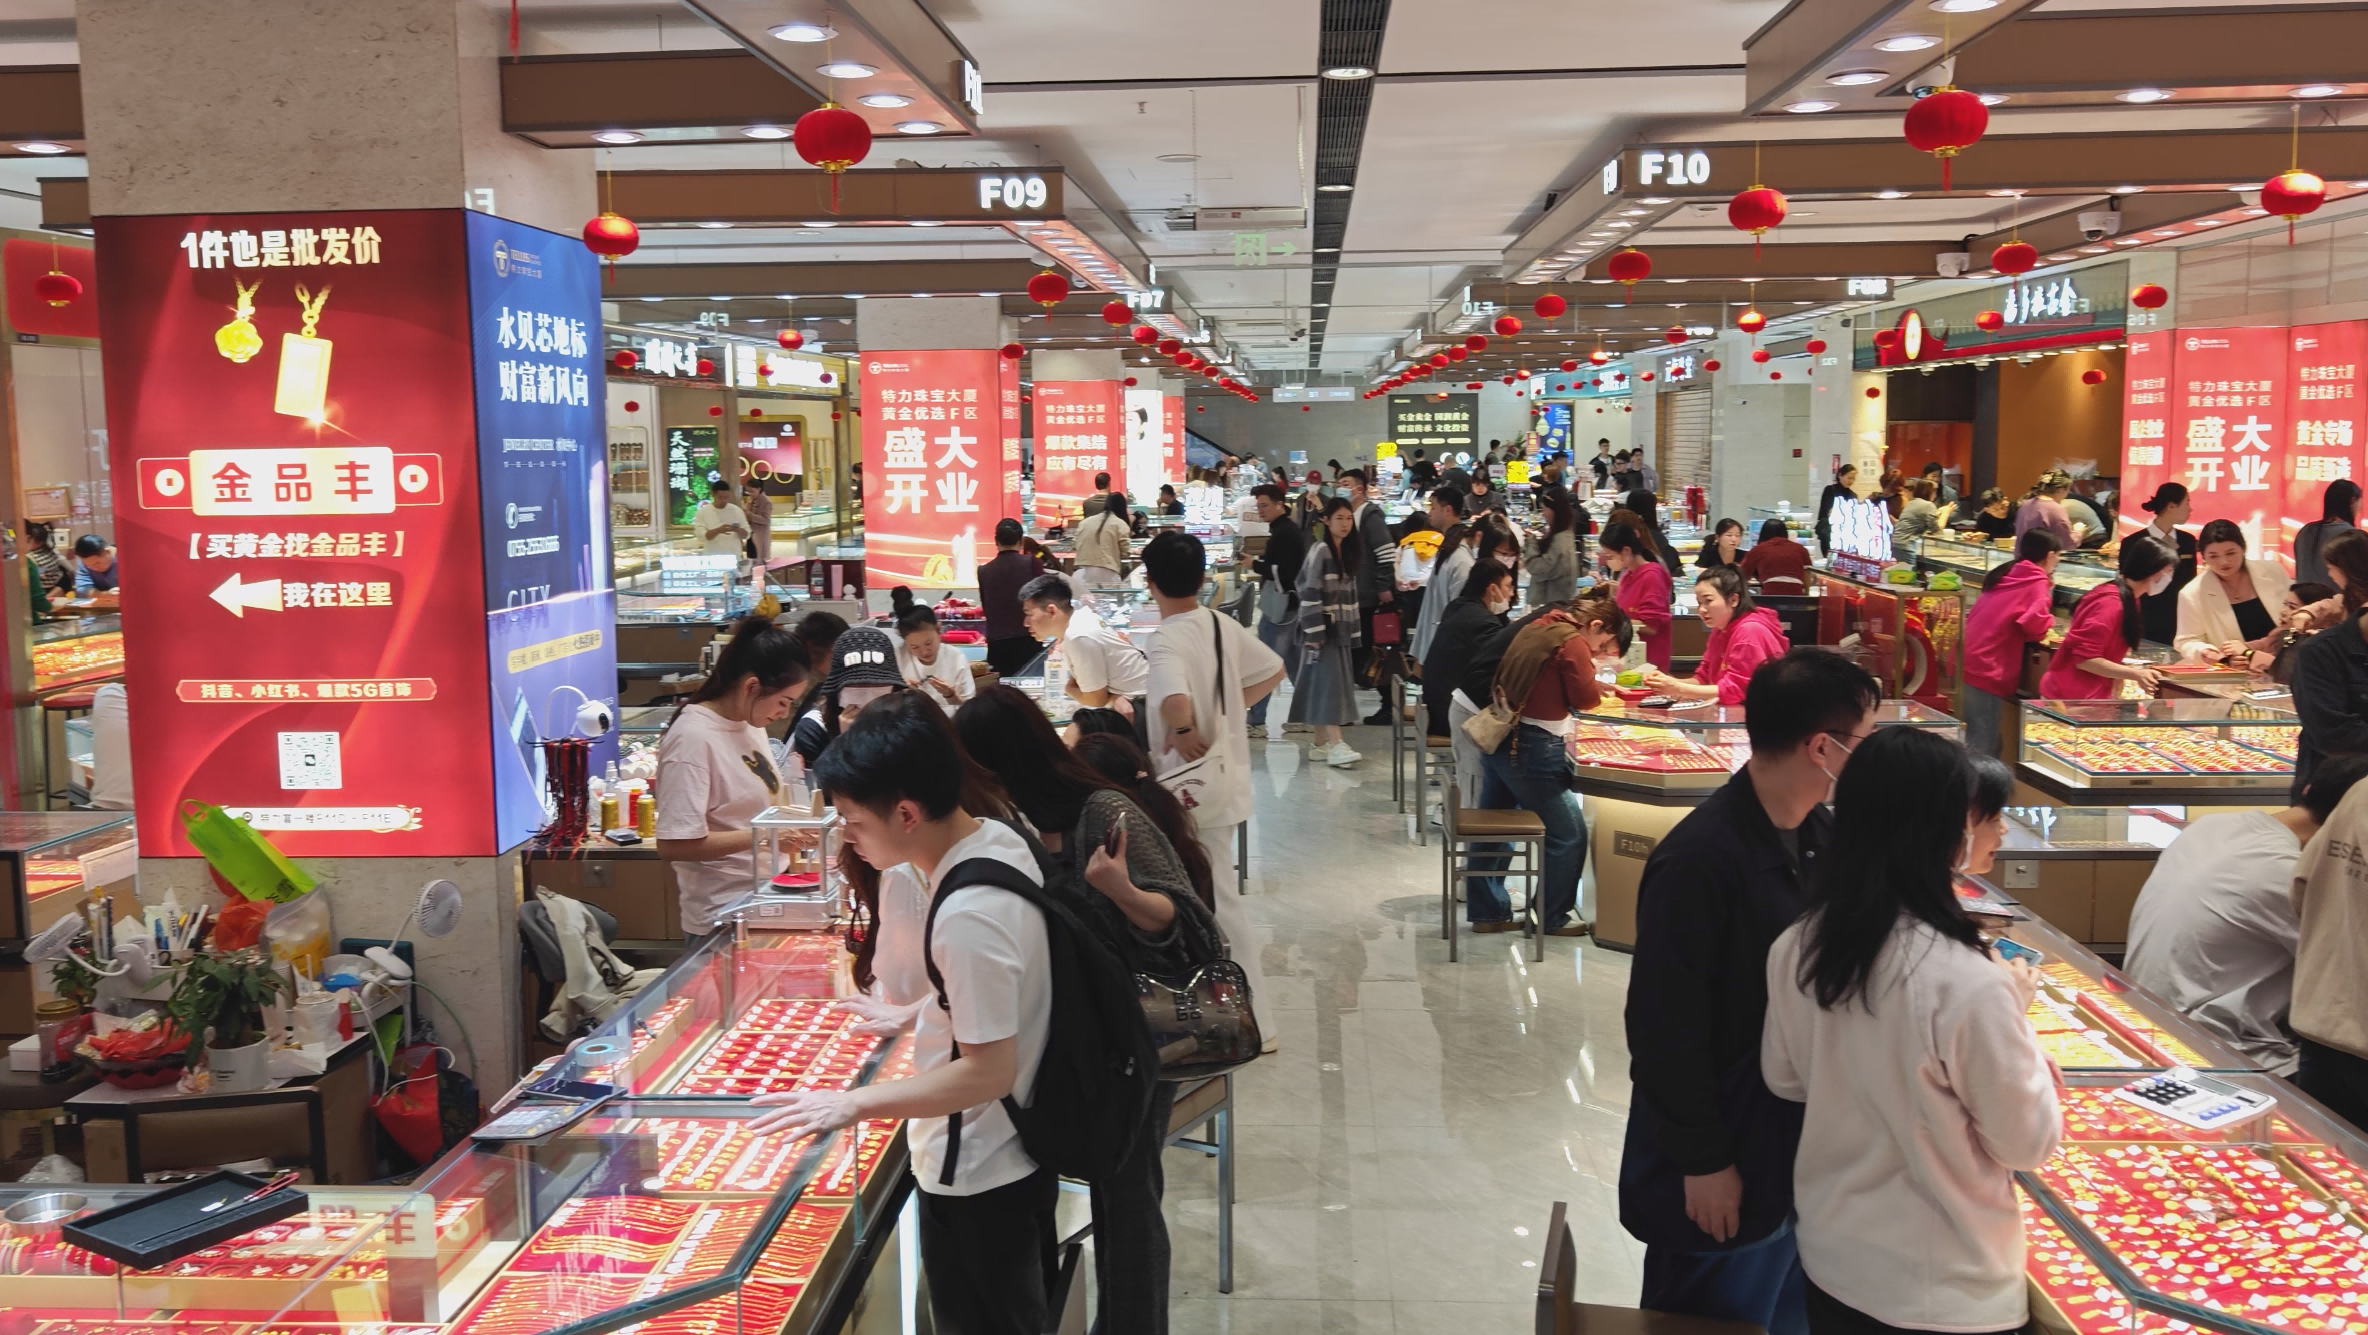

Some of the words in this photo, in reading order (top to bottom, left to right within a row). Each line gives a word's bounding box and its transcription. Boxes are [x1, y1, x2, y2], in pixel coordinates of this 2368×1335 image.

[1640, 153, 1710, 185] F10
[979, 177, 1047, 209] F09
[180, 226, 382, 268] 1件也是批发价
[1127, 289, 1164, 309] F07
[496, 306, 588, 358] 水贝芯地标
[498, 360, 589, 407] 财富新风向
[881, 389, 978, 403] 特力珠宝大厦
[2187, 380, 2273, 393] 特力珠宝大厦
[881, 406, 978, 421] 黄金优选F区
[884, 426, 979, 469] 盛大
[2185, 415, 2272, 453] 盛大
[211, 461, 374, 503] 金品丰
[2185, 455, 2271, 492] 开业
[884, 472, 980, 515] 开业
[189, 530, 406, 560] 【买黄金找金品丰】
[283, 582, 394, 608] 我在这里
[507, 585, 551, 614] CITY
[200, 683, 413, 699] 抖音、小红书、爆款5G首饰
